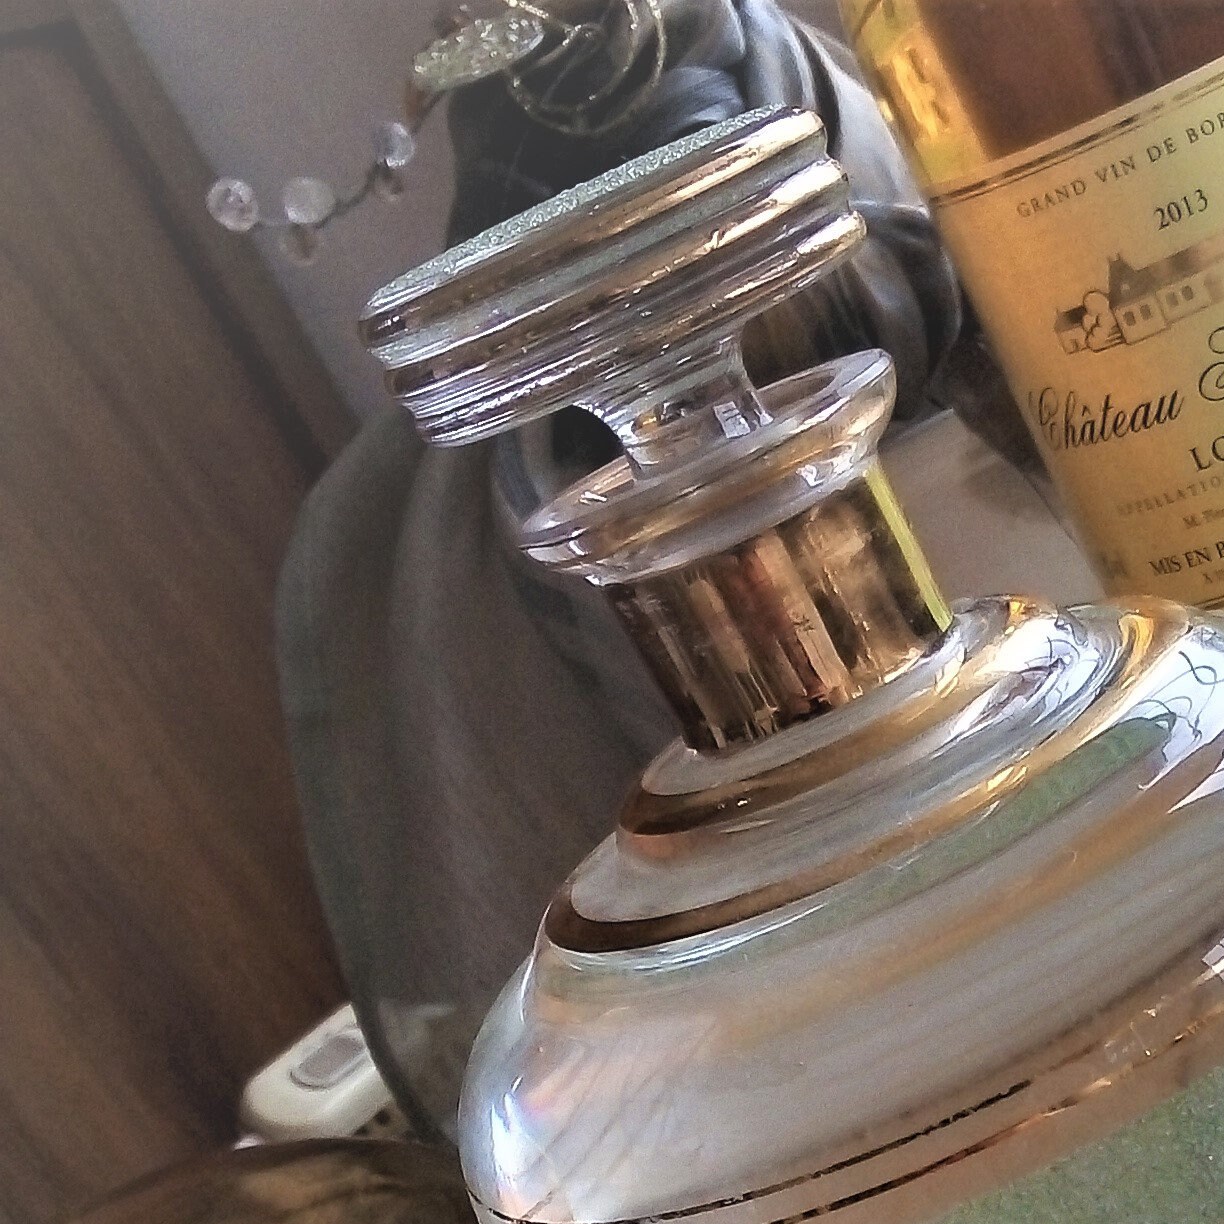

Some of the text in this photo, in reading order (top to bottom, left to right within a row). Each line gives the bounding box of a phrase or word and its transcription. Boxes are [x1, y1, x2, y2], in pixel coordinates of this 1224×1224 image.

[1015, 178, 1087, 218] GRAND
[1094, 155, 1138, 184] VIN
[1145, 136, 1177, 163] DE
[1152, 188, 1209, 231] 2013
[1028, 386, 1185, 452] Château
[1148, 554, 1183, 576] MIS
[1182, 546, 1213, 568] EN
